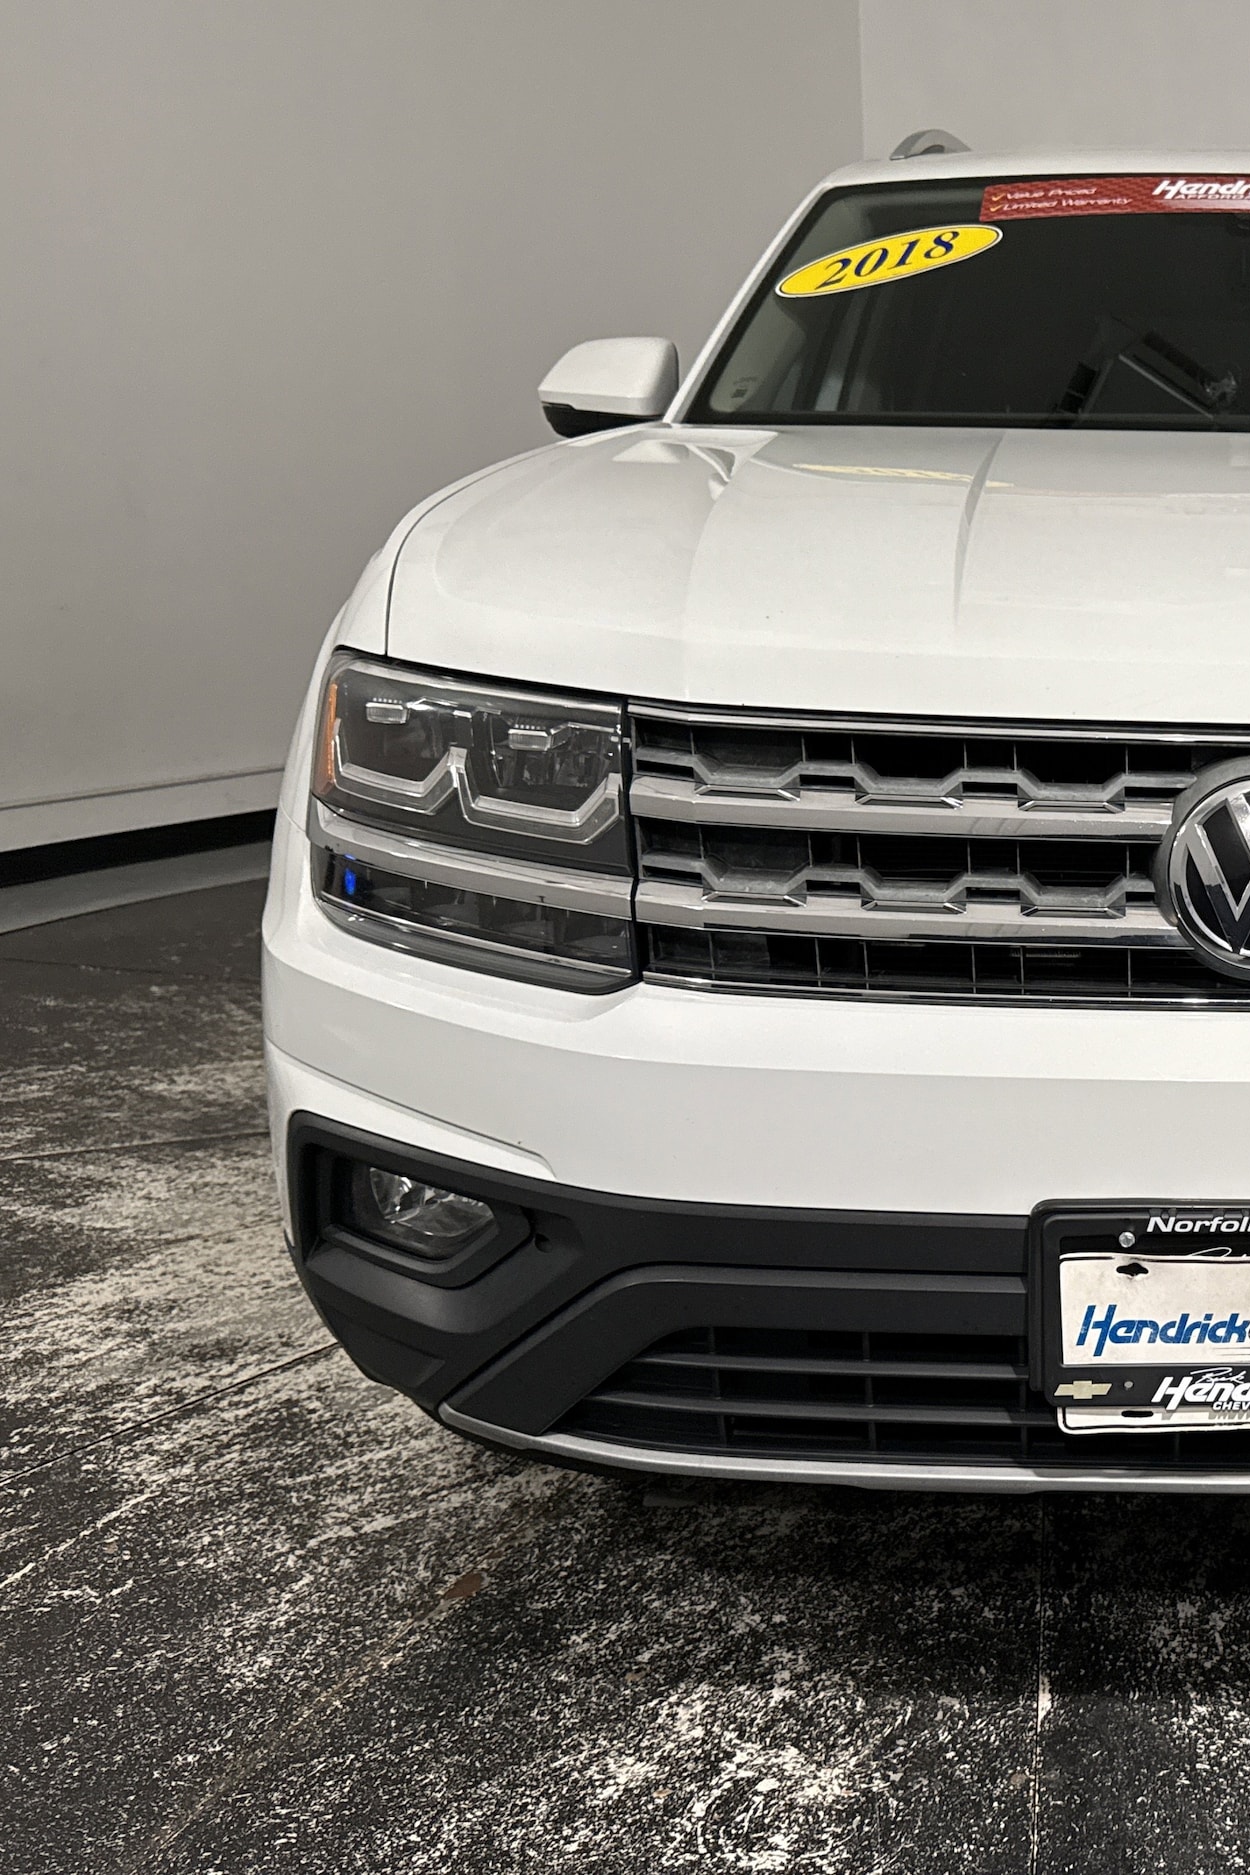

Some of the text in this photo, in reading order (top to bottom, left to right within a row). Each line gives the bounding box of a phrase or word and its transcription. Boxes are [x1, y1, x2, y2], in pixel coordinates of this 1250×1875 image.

[1006, 191, 1045, 200] Value
[1002, 197, 1134, 211] Limited Warranty
[814, 230, 961, 291] 2018
